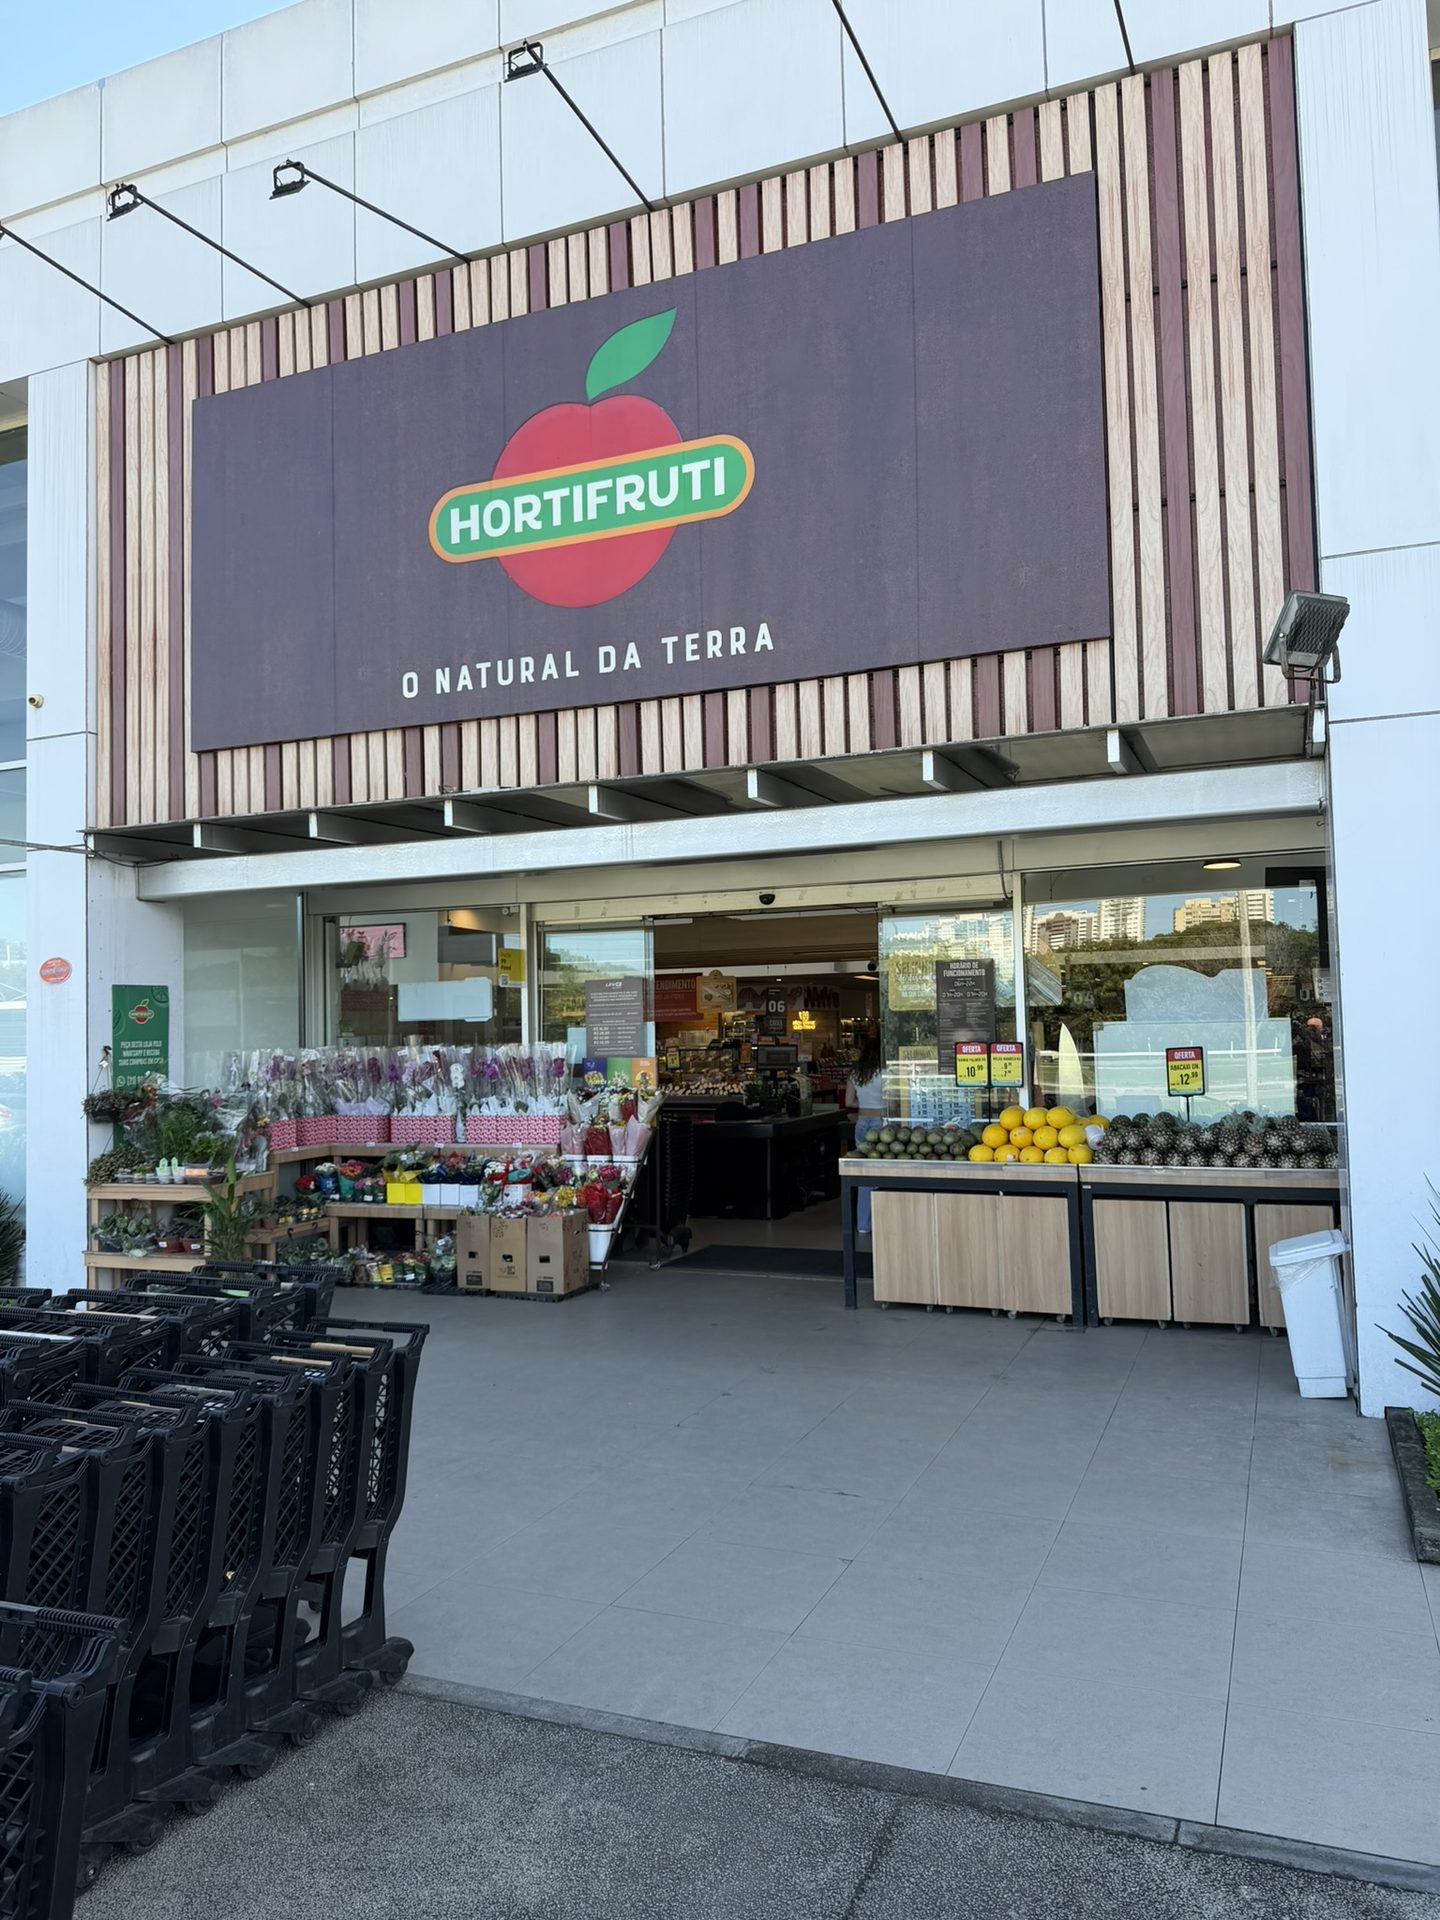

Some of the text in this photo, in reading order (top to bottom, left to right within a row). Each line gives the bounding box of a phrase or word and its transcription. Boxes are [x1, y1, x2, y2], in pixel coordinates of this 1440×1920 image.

[449, 456, 726, 545] HORTIFRUTI
[402, 622, 774, 699] O NATURAL DA TERRA
[768, 1000, 785, 1013] 06
[962, 1045, 982, 1053] OFERTA
[996, 1044, 1016, 1052] OFERTA
[1174, 1051, 1196, 1060] OFERTA
[1170, 1063, 1191, 1071] ABACAXI
